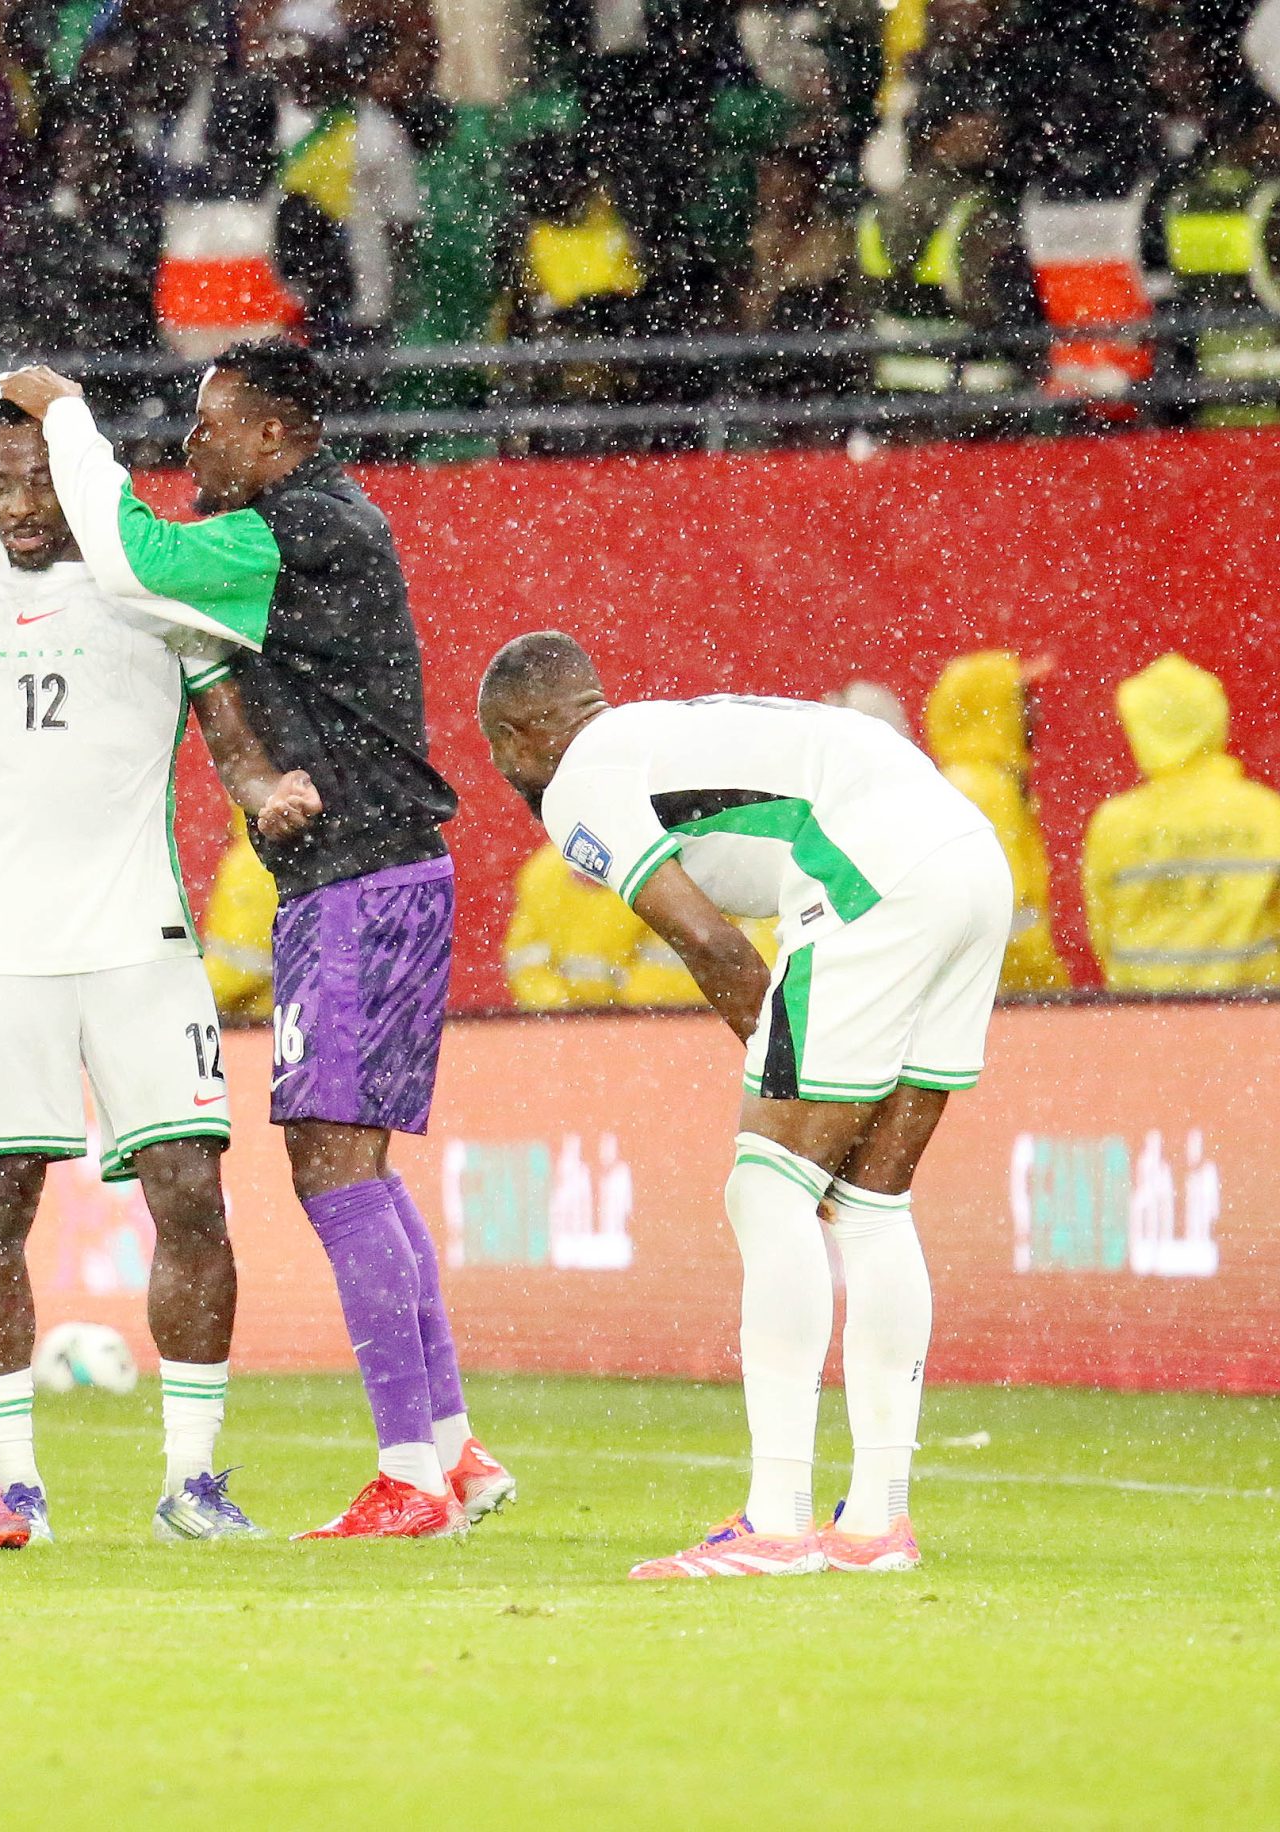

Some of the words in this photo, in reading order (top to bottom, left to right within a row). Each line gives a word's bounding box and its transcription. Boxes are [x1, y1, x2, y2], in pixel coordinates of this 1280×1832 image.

[18, 673, 69, 731] 12
[185, 1022, 226, 1083] 12
[273, 1003, 304, 1067] 16
